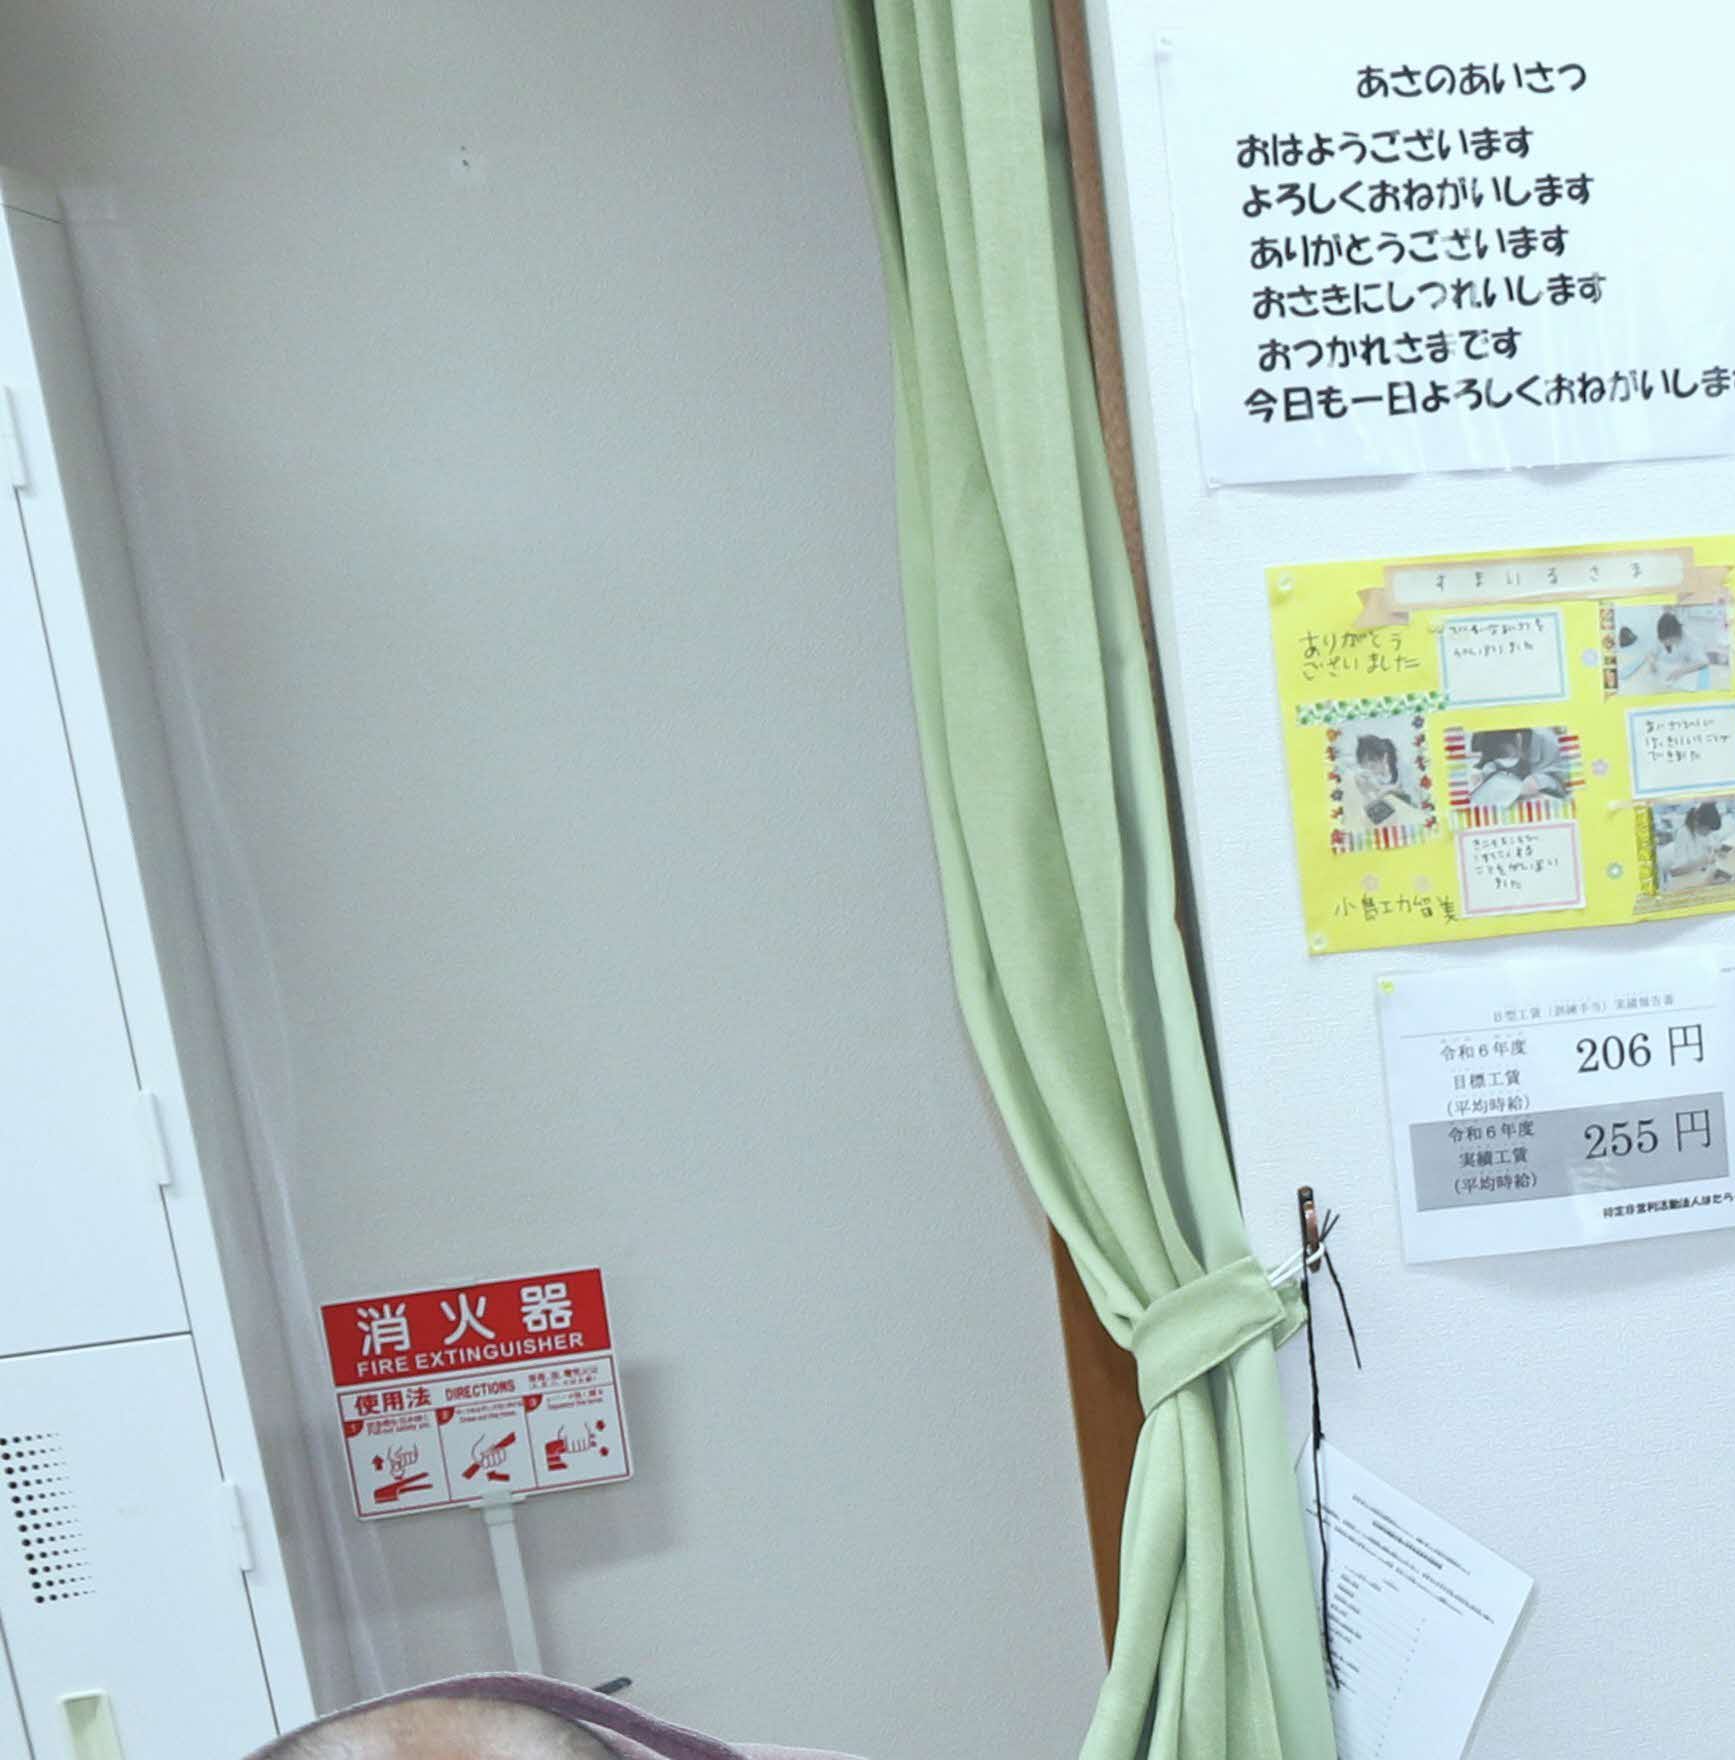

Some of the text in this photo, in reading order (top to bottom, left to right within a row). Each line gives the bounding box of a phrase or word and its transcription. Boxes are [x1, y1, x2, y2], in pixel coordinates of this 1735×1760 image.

[1356, 61, 1588, 98] あさのあいさつ
[1236, 125, 1534, 168] おはようございます
[1241, 172, 1595, 218] よろしくおねがいします
[1249, 224, 1569, 270] ありがとうございます
[1252, 271, 1606, 320] おさきにしつれいします
[1257, 326, 1523, 372] おつかれさまです
[1441, 1023, 1706, 1074] 令和6年度 206 円
[1454, 1068, 1521, 1090] 目標工賃
[1448, 1108, 1712, 1161] 令和6年度 255 円
[1459, 1146, 1529, 1168] 実績工賃
[356, 1282, 574, 1357] 消火器
[357, 1332, 585, 1378] FIRE EXTINGUISHER
[354, 1386, 433, 1416] 使用法
[445, 1379, 516, 1402] DIRECTIONS
